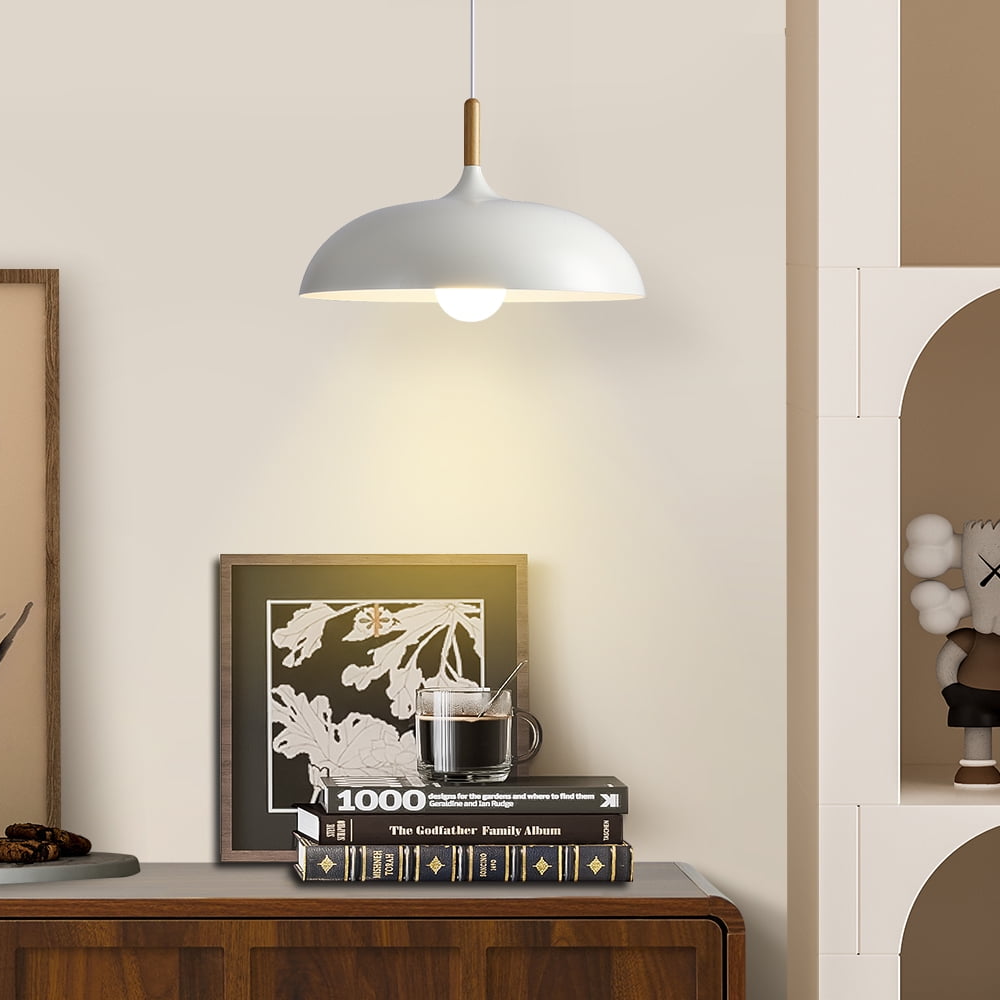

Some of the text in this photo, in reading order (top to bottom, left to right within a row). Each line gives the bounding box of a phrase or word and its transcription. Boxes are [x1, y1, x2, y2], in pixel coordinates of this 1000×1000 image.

[337, 789, 426, 811] 1000
[428, 792, 456, 801] designs
[482, 792, 511, 801] gardens
[491, 800, 514, 808] Rudge
[389, 825, 562, 837] The Godfather Family Album
[384, 853, 395, 876] TORAH
